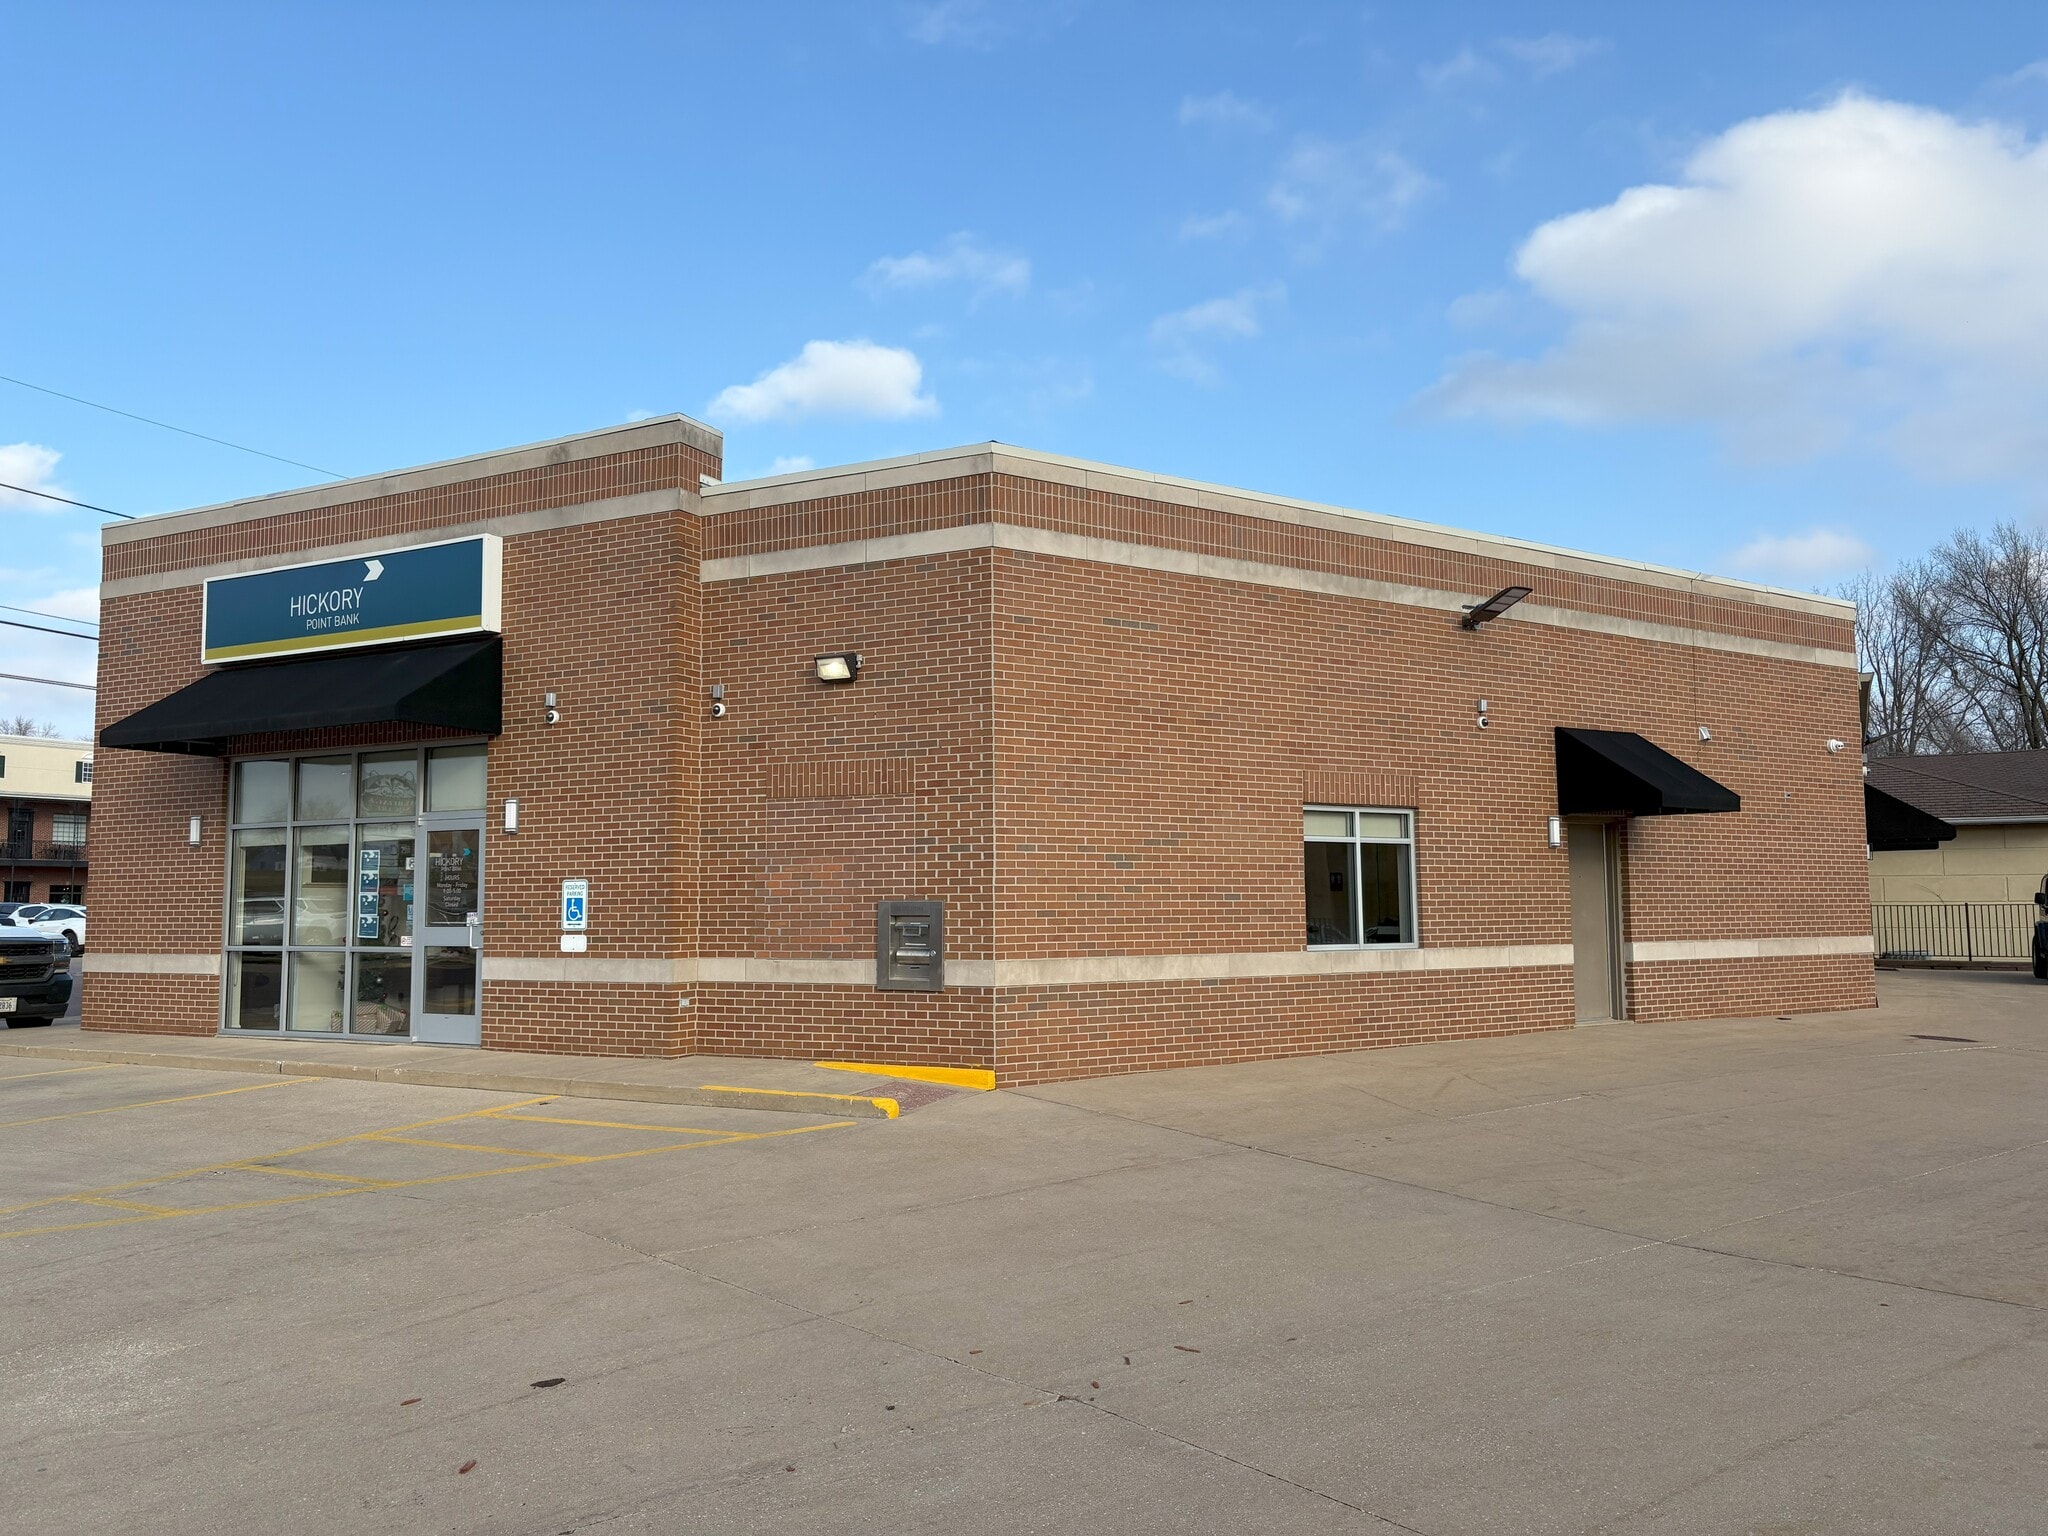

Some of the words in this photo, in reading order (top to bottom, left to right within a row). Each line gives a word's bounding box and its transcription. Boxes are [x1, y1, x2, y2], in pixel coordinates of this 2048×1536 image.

[290, 587, 363, 617] HICKORY
[306, 616, 332, 630] POINT
[334, 613, 360, 627] BANK
[435, 858, 463, 866] HICKORY
